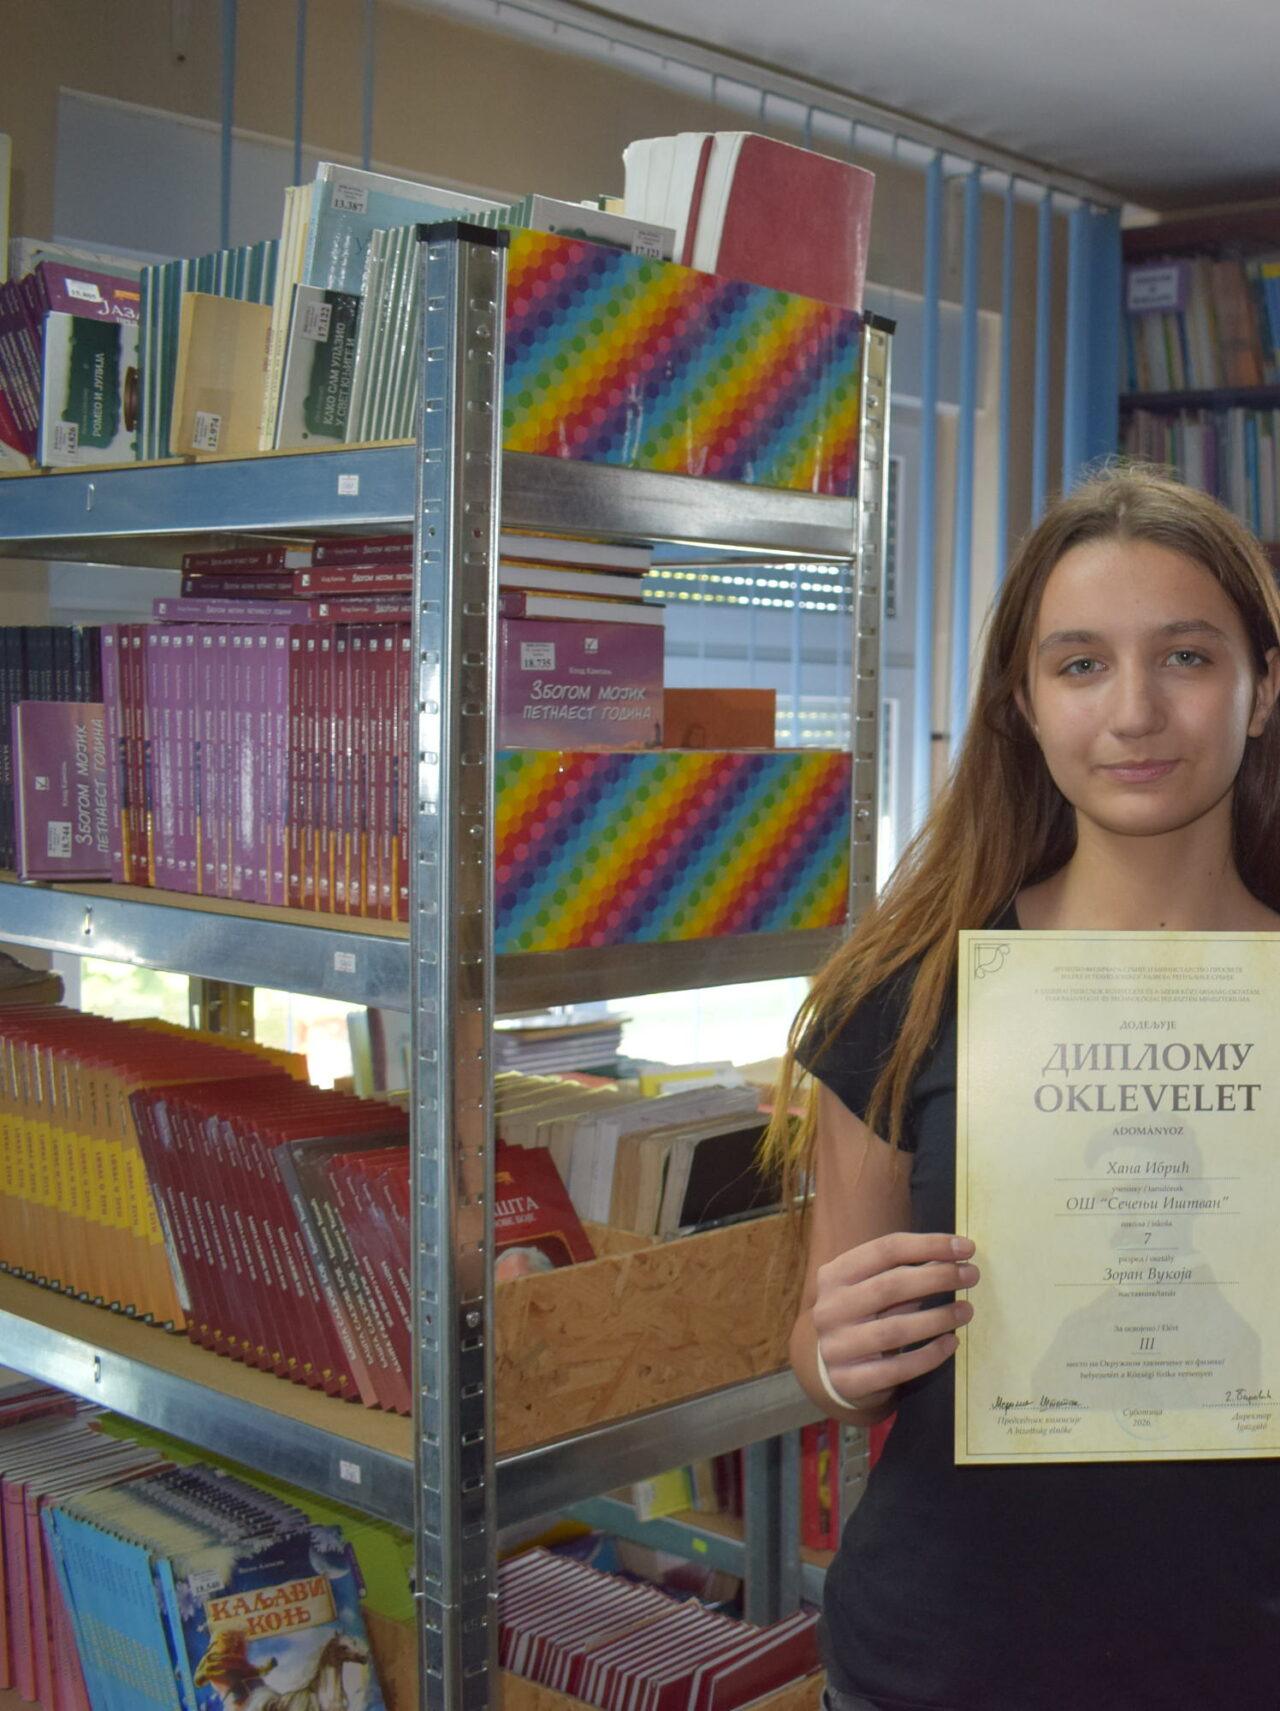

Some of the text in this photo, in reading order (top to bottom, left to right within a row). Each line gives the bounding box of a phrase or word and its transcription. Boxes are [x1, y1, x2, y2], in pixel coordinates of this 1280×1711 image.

[92, 353, 105, 391] ЈУЛИЈА
[323, 322, 346, 425] КАКО САМ УЛАЗИО
[337, 390, 348, 415] СВЕТ
[92, 401, 104, 437] РОМЕО
[530, 679, 592, 700] ЗБОГОМ
[522, 705, 652, 721] ПЕТНАЕСТ ГОДИНА
[91, 718, 110, 853] ПЕТНАЕСТ ГОДИНА
[75, 783, 93, 847] ЗБОГОМ
[1119, 1020, 1177, 1031] ДОДЕЉУЈЕ
[1041, 1042, 1255, 1078] ДИПЛОМУ
[1034, 1083, 1262, 1113] OKLEVELET
[1106, 1160, 1190, 1178] Хана Ибрић
[495, 1196, 539, 1217] ШТА
[1066, 1196, 1095, 1210] ОШ
[1144, 1232, 1152, 1245] 7
[1103, 1266, 1193, 1284] Зоран Вукоја
[1139, 1337, 1155, 1350] III
[209, 1576, 328, 1622] КАЉАВИ
[246, 1606, 312, 1637] КОЊ
